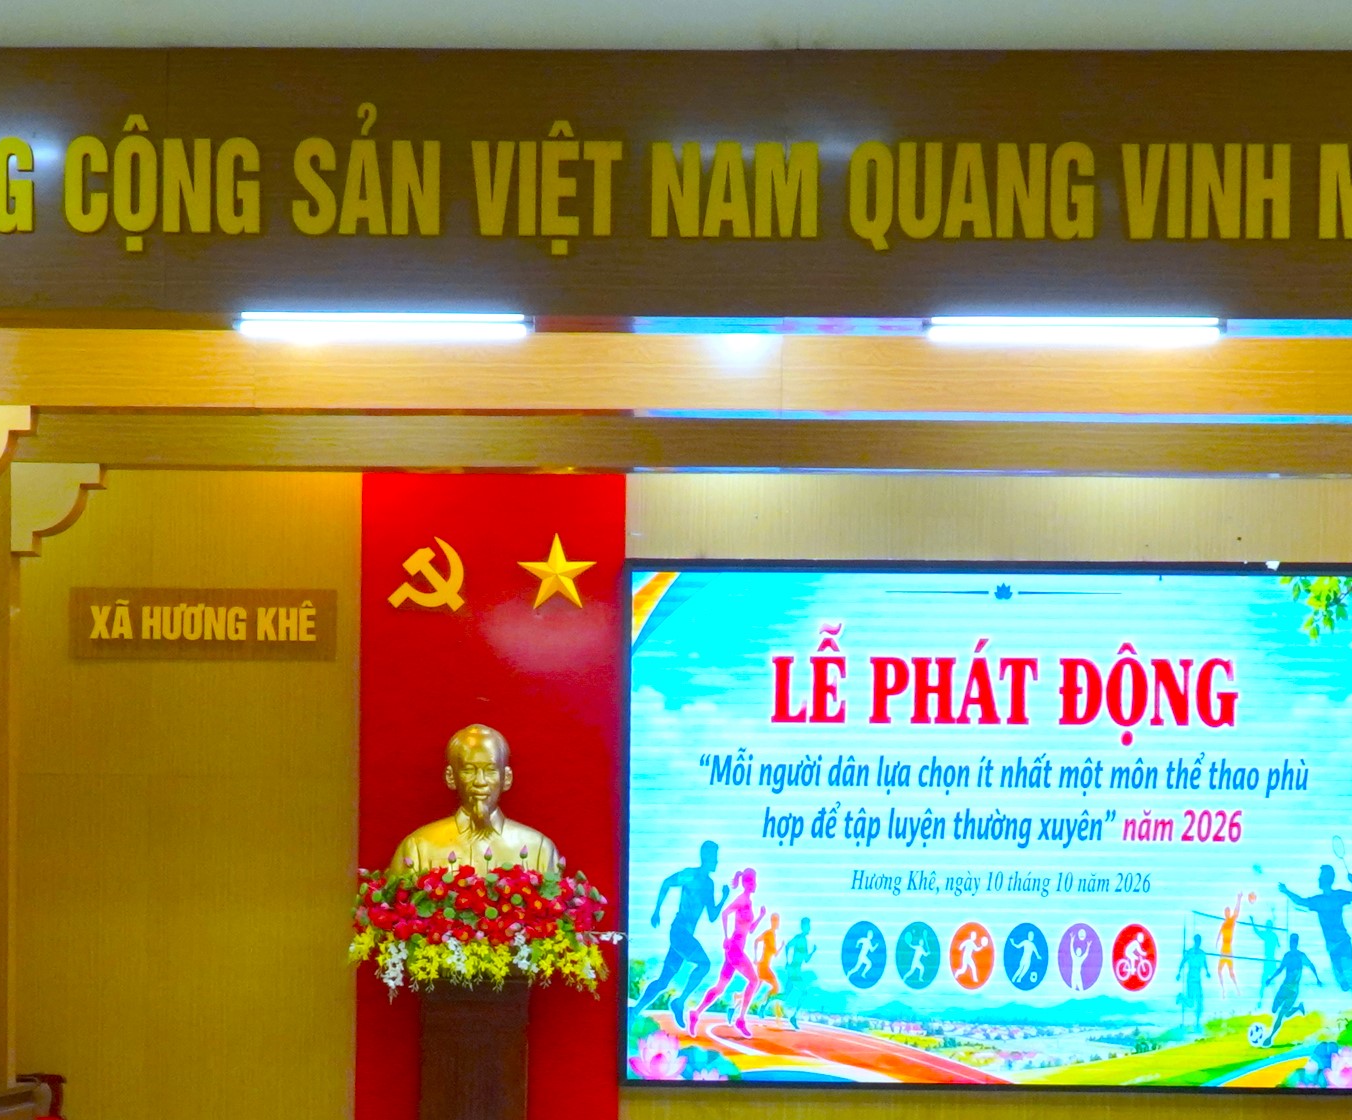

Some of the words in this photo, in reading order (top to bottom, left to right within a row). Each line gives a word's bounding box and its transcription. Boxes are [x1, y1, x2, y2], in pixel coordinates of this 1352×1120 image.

[64, 115, 260, 252] CỘNG
[293, 102, 440, 237] SẢN
[471, 120, 623, 255] VIỆT
[651, 142, 817, 239] NAM
[849, 142, 1095, 250] QUANG
[1122, 143, 1290, 240] VINH
[89, 599, 133, 640] XÃ
[142, 603, 247, 641] HƯƠNG
[257, 600, 317, 642] KHÊ
[771, 623, 846, 723] LỄ
[869, 638, 1038, 724] PHÁT
[1058, 642, 1238, 746] ĐỘNG
[699, 748, 753, 786] “Mỗi
[759, 755, 822, 794] người
[828, 755, 869, 787] dân
[877, 756, 911, 795] lựa
[918, 756, 970, 795] chọn
[977, 756, 993, 787] ít
[1000, 753, 1052, 788] nhất
[1059, 757, 1103, 796] một
[1110, 757, 1158, 789] môn
[1166, 752, 1205, 789] thể
[1209, 759, 1259, 790] thao
[1265, 759, 1309, 798] phù
[762, 807, 804, 846] hợp
[811, 801, 841, 839] để
[845, 807, 880, 847] tập
[888, 807, 946, 847] luyện
[953, 808, 1032, 848] thường
[1038, 810, 1116, 848] xuyên”
[1123, 809, 1174, 841] năm
[1181, 810, 1242, 842] 2026
[851, 869, 901, 896] Hương
[907, 870, 940, 895] Khê,
[945, 871, 981, 896] ngày
[986, 871, 1003, 892] 10
[1008, 872, 1050, 897] tháng
[1056, 872, 1073, 892] 10
[1078, 873, 1110, 892] năm
[1114, 873, 1151, 893] 2026
